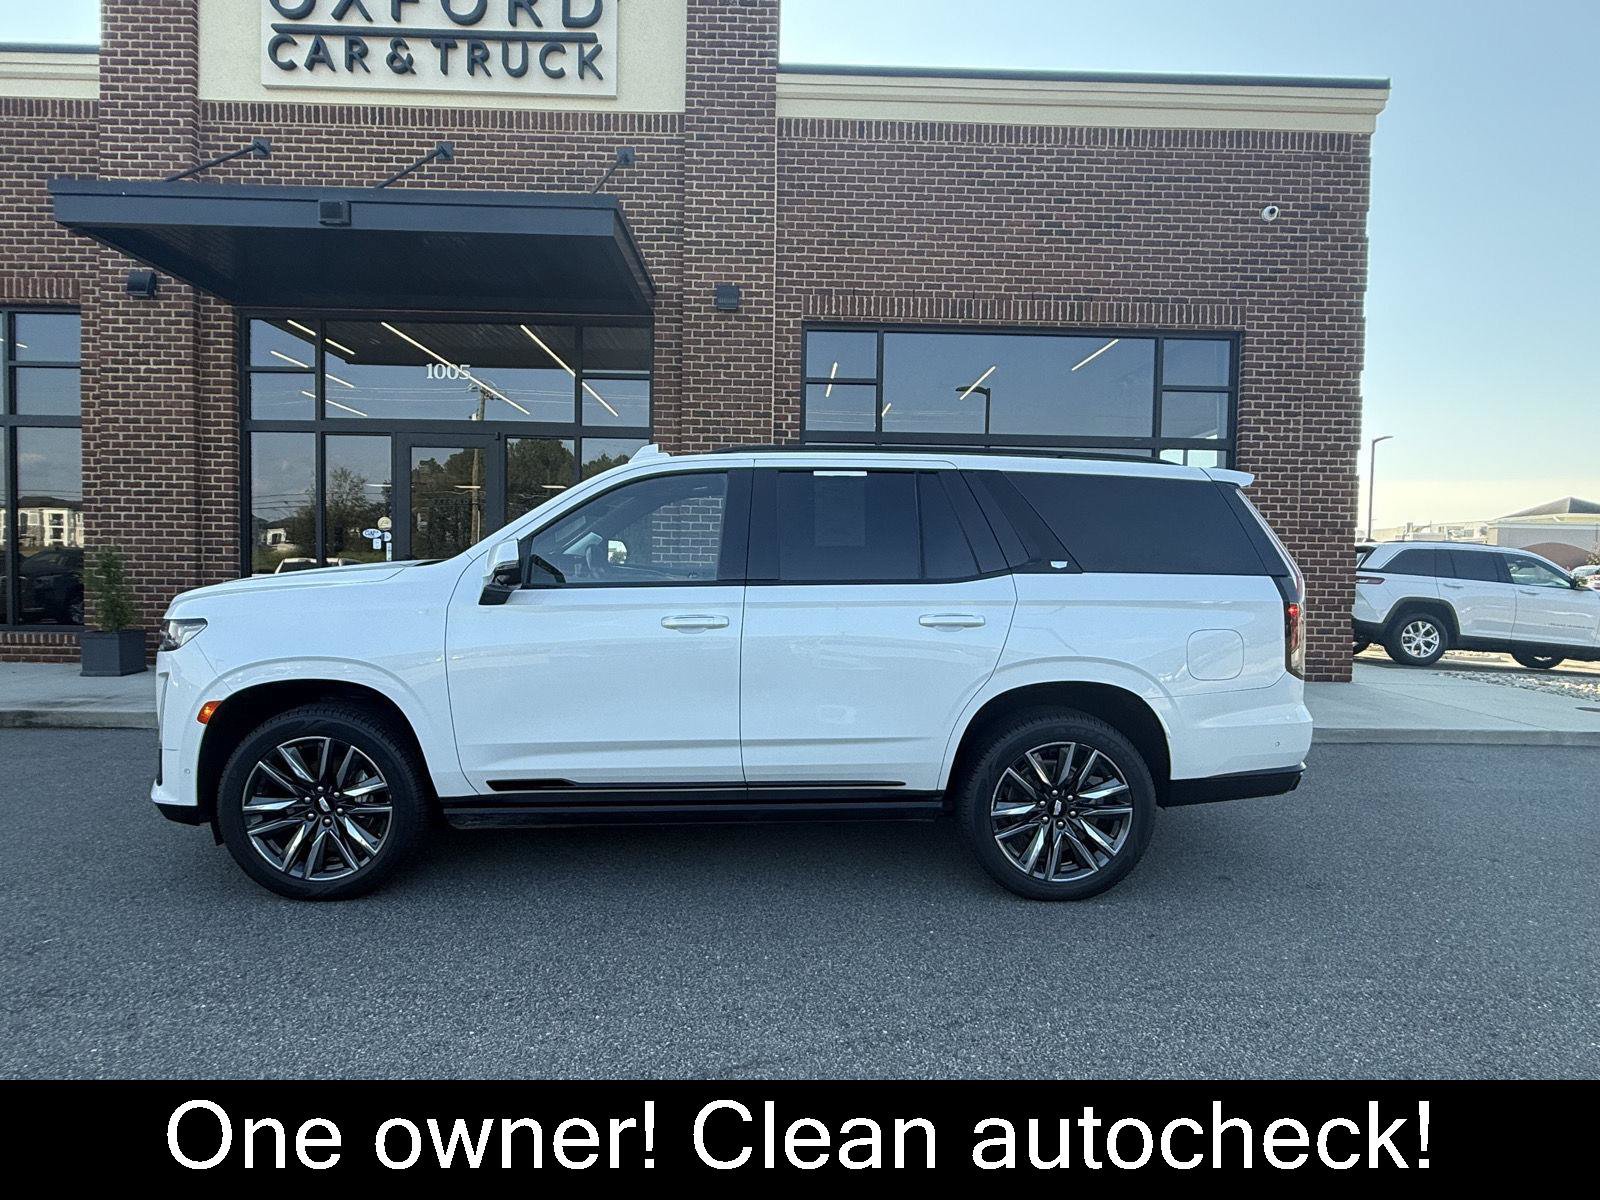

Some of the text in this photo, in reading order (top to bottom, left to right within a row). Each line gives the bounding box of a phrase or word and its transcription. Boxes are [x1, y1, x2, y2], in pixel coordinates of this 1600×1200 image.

[268, 33, 603, 80] CAR & TRUCK
[425, 363, 471, 379] 1005
